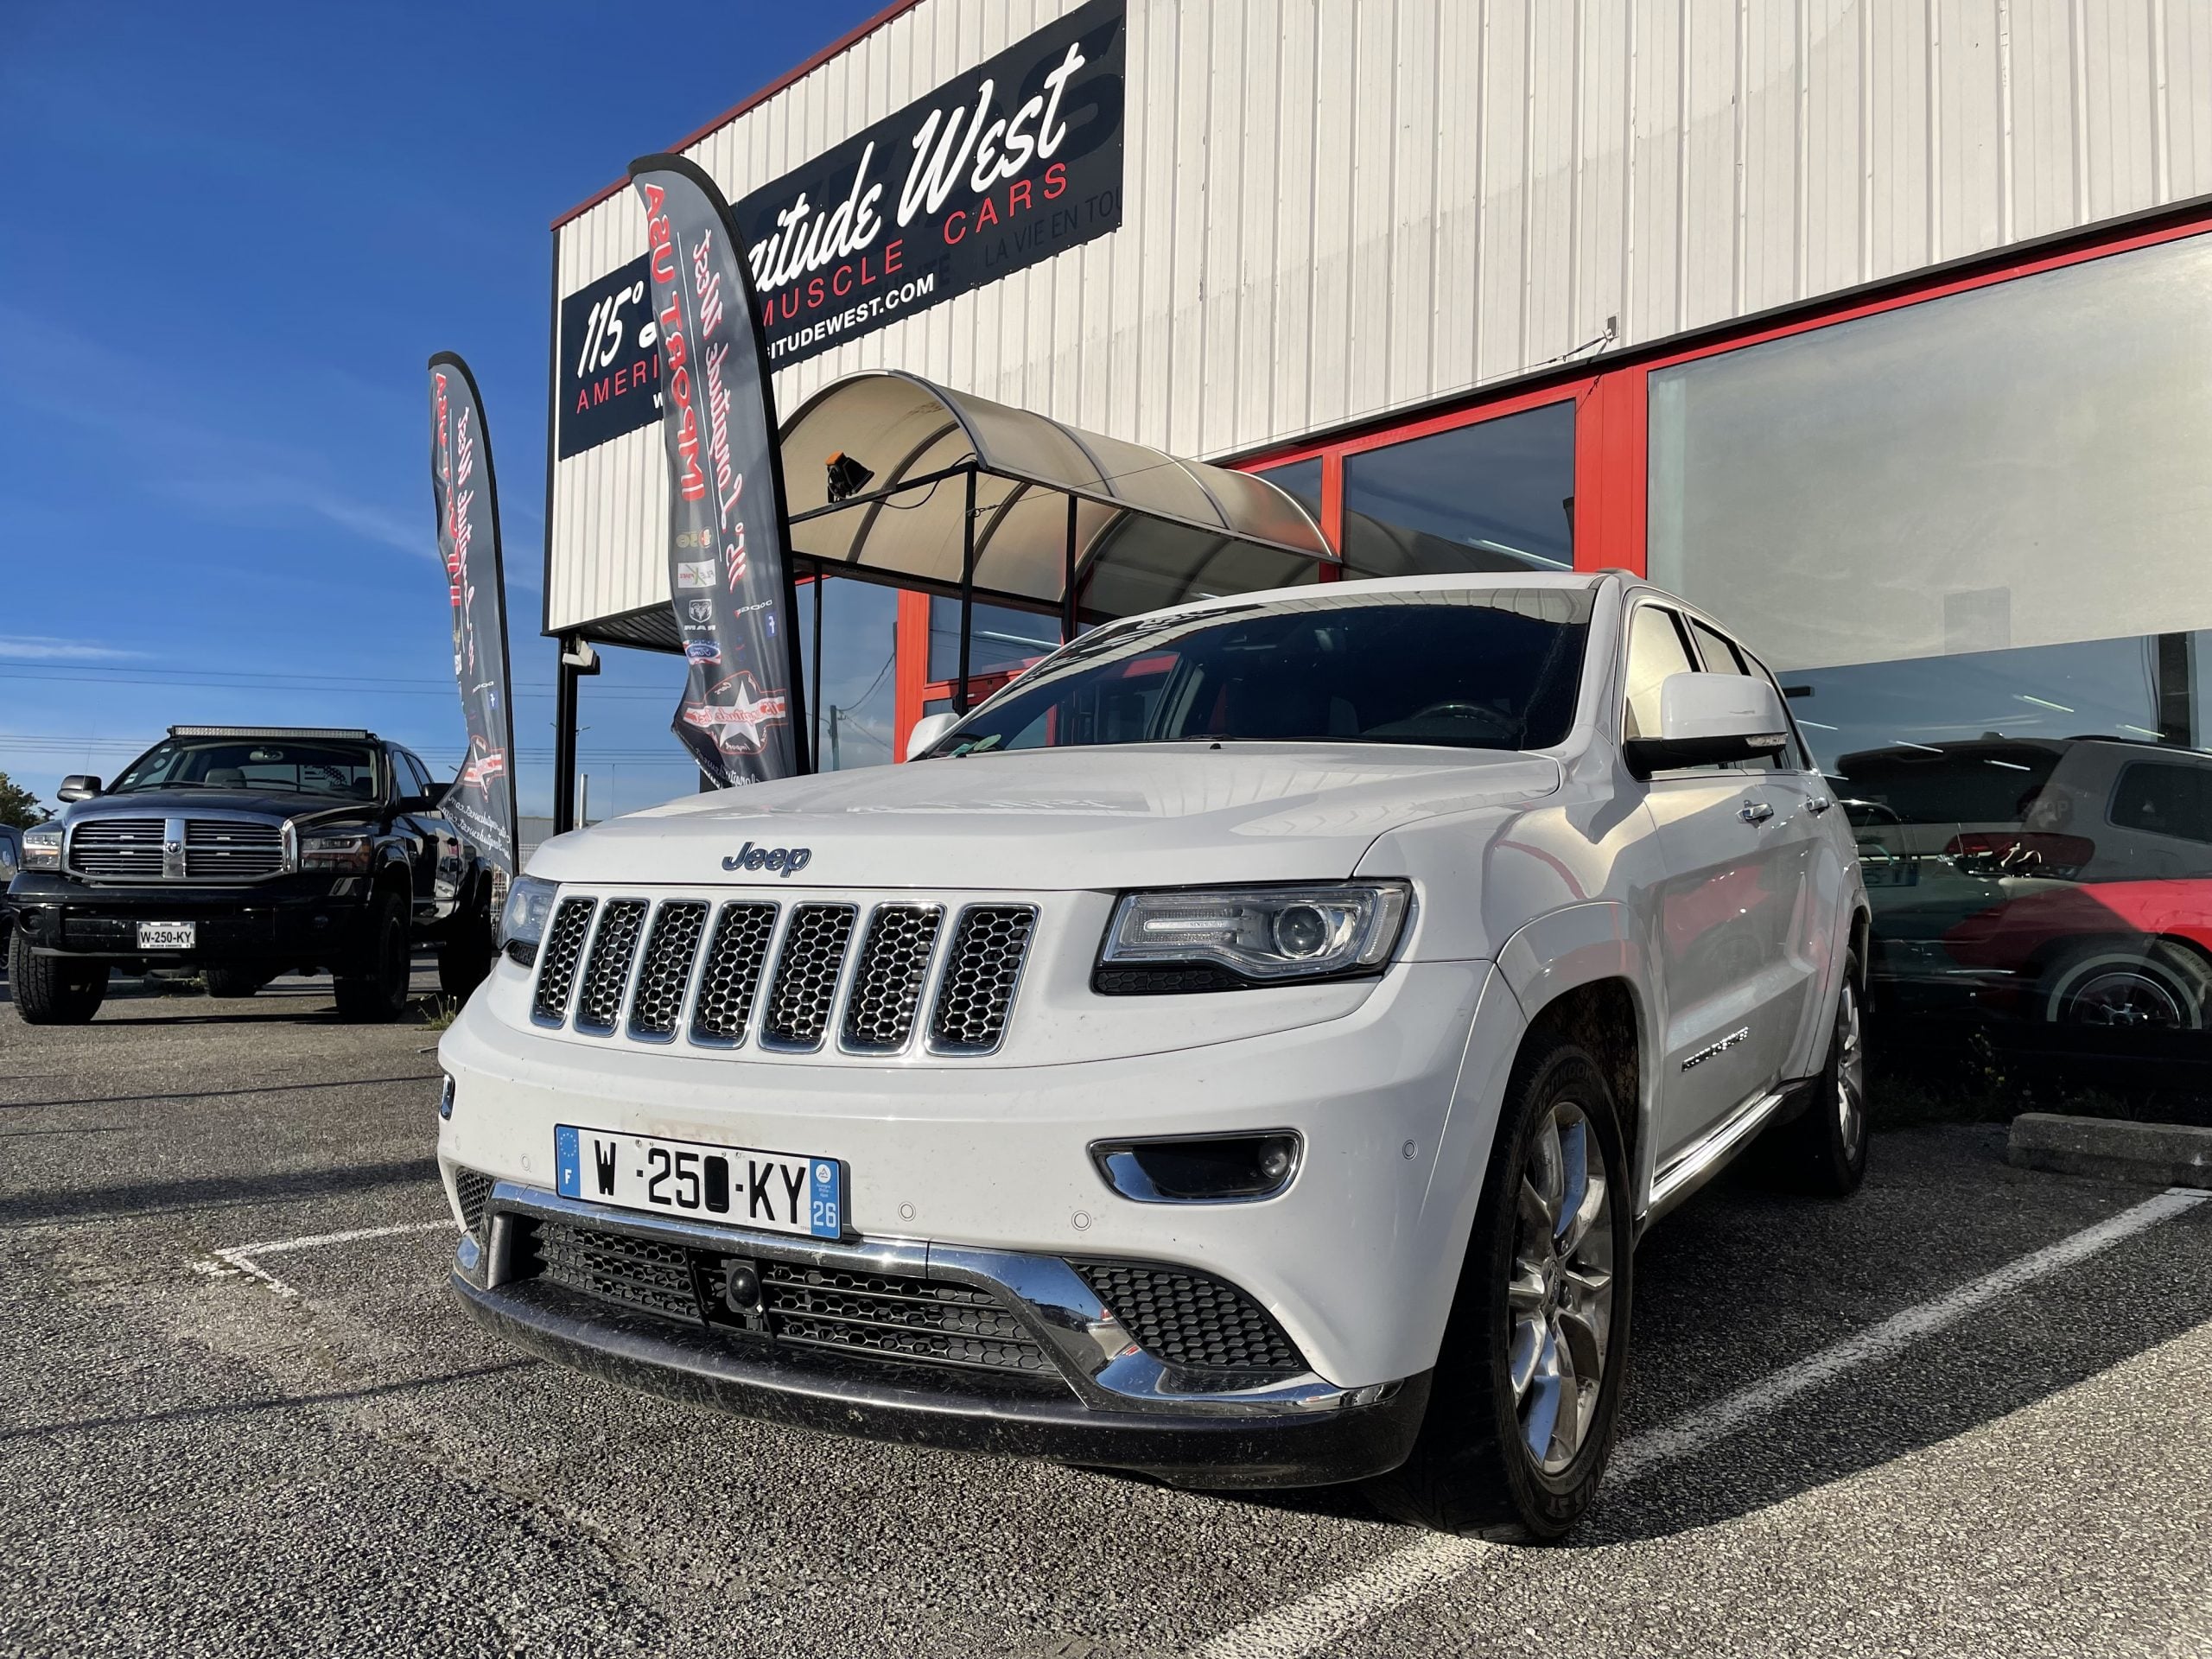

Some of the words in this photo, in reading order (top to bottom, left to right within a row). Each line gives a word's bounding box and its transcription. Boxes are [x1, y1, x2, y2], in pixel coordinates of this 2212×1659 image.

[896, 41, 1086, 228] West
[575, 354, 658, 415] AMERI
[943, 162, 1068, 245] CARS
[721, 841, 812, 879] Jeep
[140, 931, 192, 944] W-250-KY
[563, 1168, 573, 1185] F
[813, 1199, 837, 1229] 26
